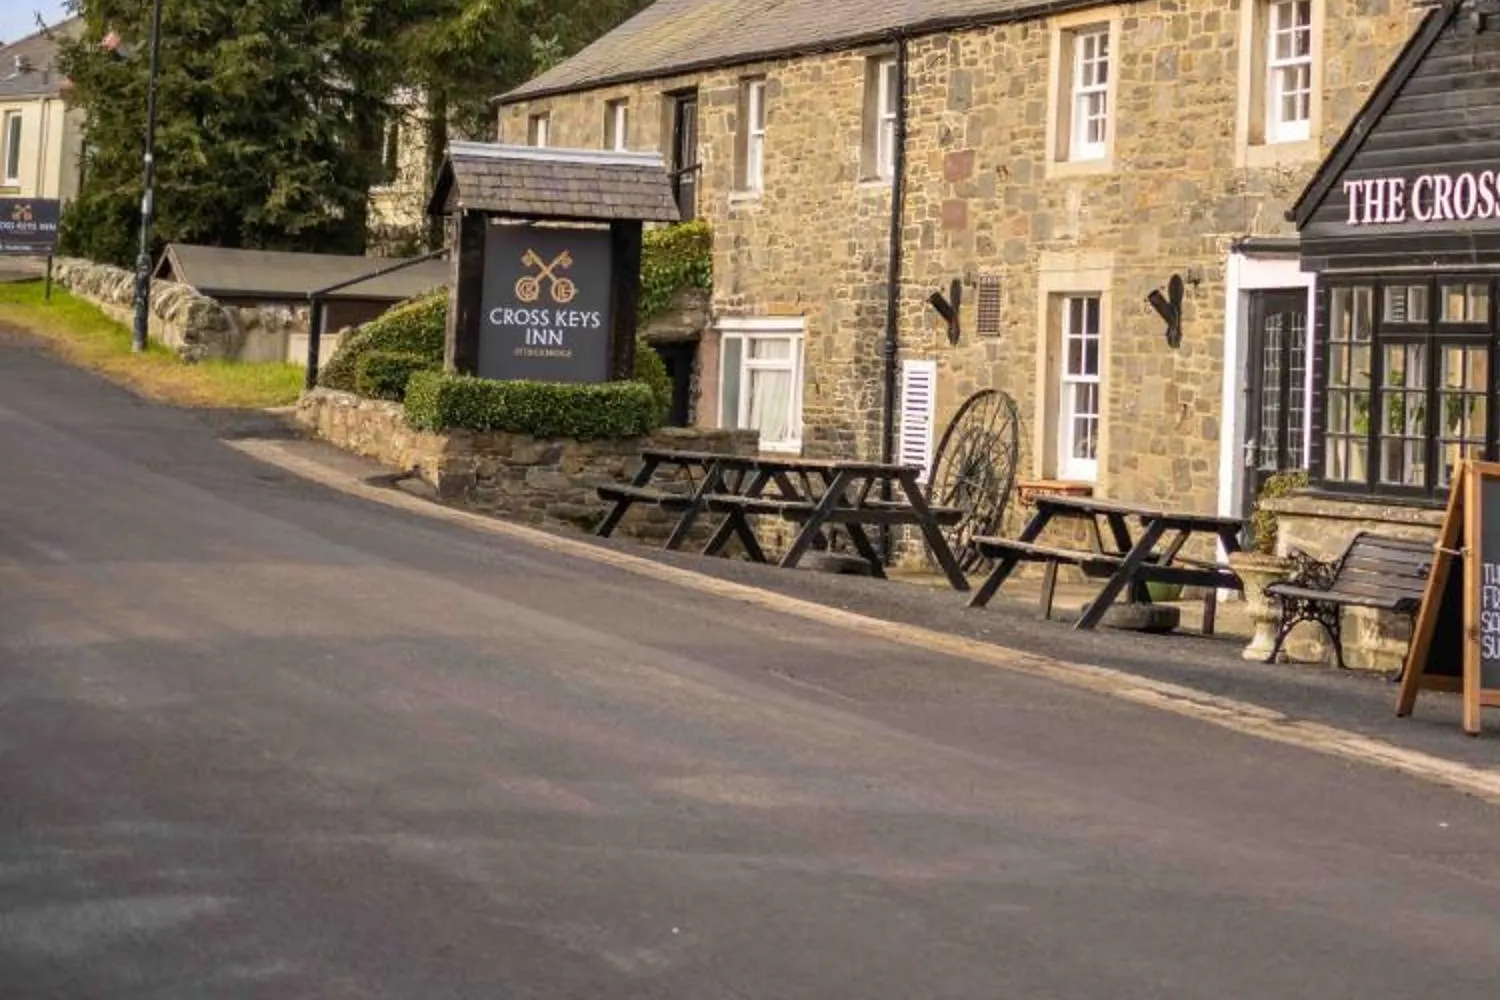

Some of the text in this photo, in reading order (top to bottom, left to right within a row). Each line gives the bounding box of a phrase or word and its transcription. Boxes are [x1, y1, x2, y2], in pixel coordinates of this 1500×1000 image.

[1343, 177, 1405, 225] THE
[489, 308, 601, 328] CROSS KEYS
[525, 328, 564, 345] INN
